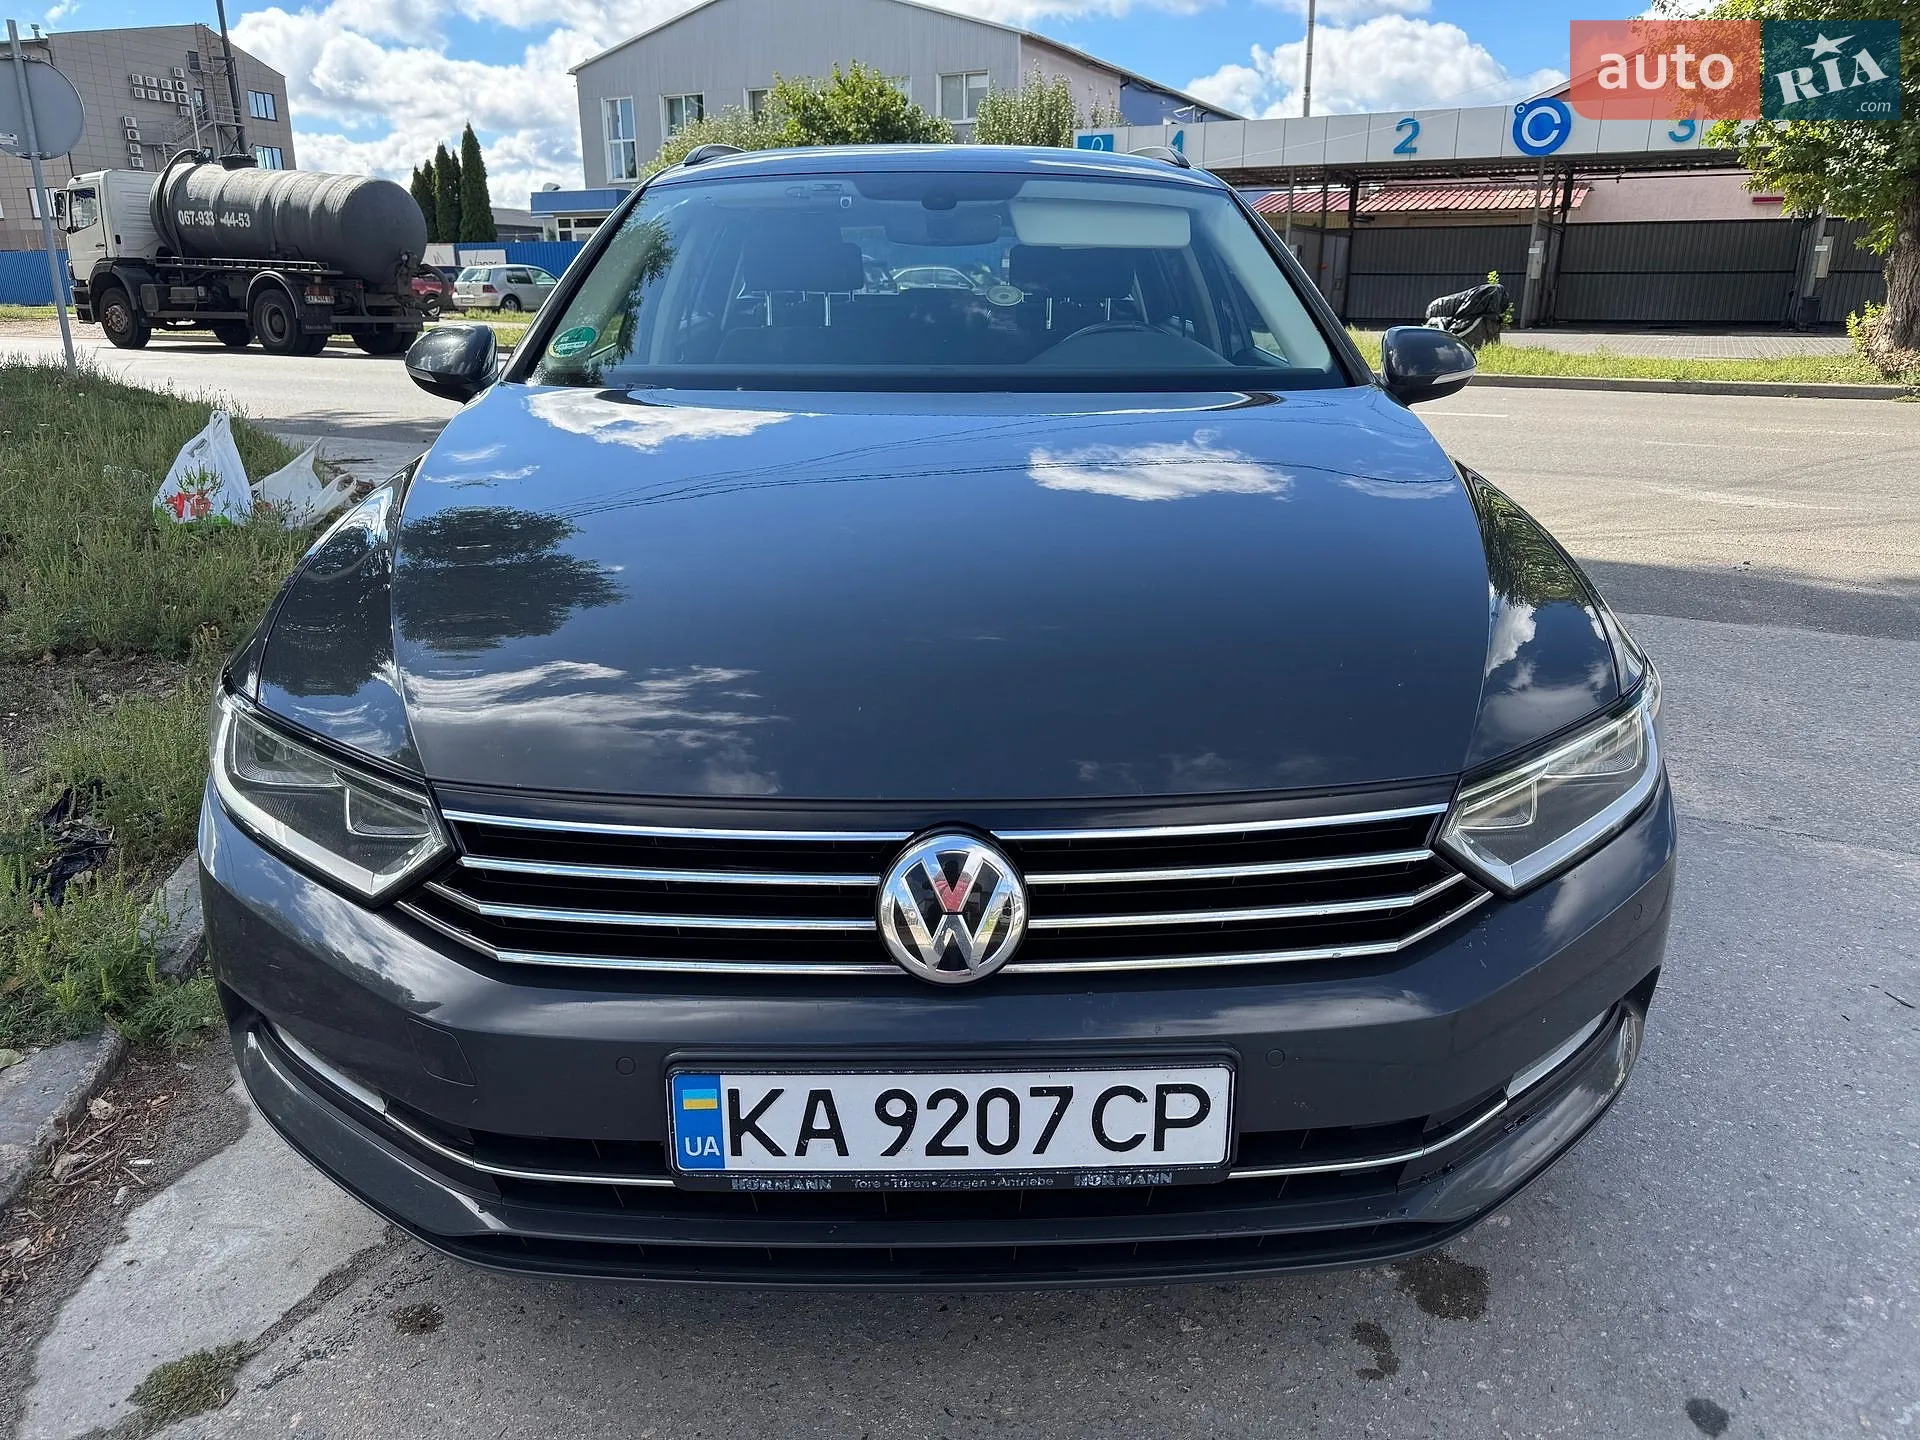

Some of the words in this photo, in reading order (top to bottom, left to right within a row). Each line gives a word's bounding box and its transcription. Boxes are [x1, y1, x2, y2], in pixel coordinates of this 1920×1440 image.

[1171, 130, 1184, 153] 1
[1393, 118, 1421, 154] 2
[727, 1088, 849, 1157] KA
[874, 1086, 1074, 1157] 9207
[1091, 1083, 1212, 1152] CP
[684, 1136, 720, 1157] UA
[852, 1178, 881, 1189] Tore
[890, 1177, 929, 1189] Türen
[939, 1178, 988, 1190] Zargen
[997, 1176, 1054, 1188] Antriebe
